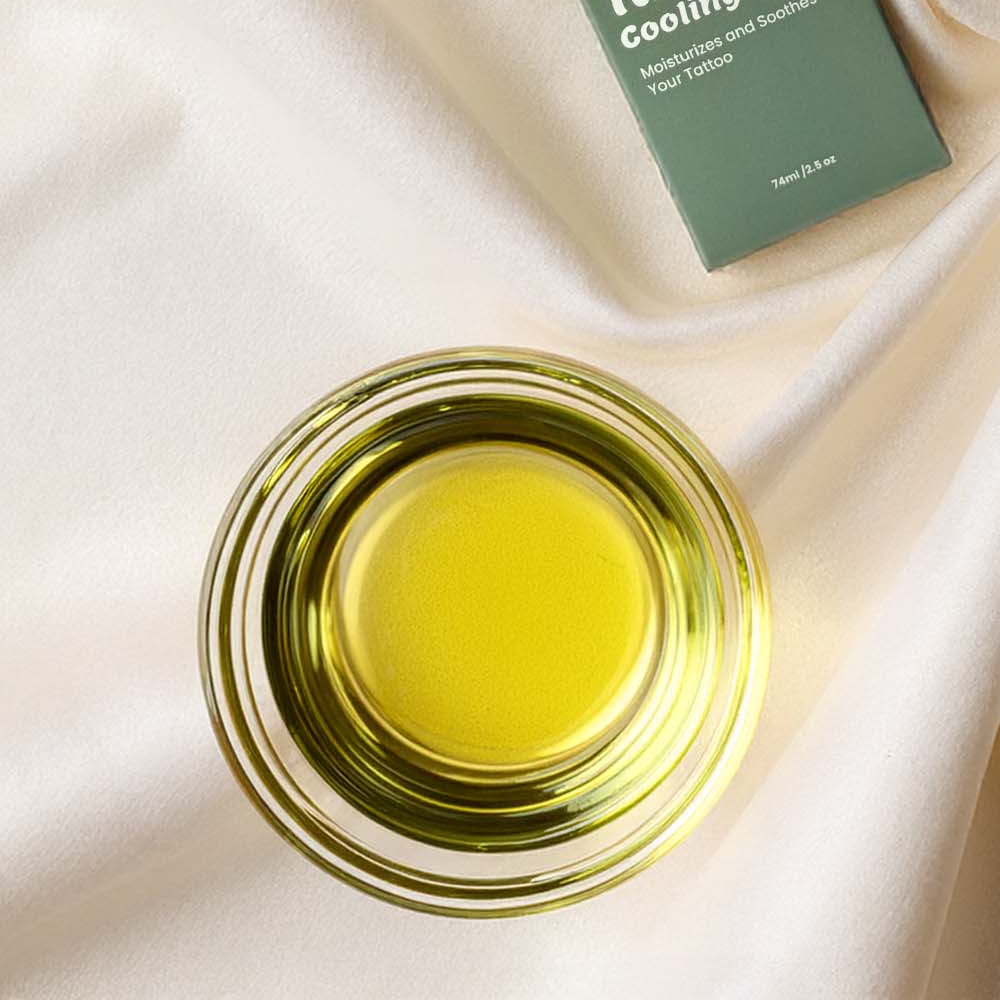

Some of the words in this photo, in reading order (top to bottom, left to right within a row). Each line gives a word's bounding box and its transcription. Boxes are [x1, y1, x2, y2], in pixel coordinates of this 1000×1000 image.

[639, 36, 723, 80] Moisturizes
[725, 20, 756, 43] and
[647, 73, 682, 96] Your
[683, 52, 734, 81] Tattoo
[770, 169, 800, 190] 74ml
[823, 155, 837, 166] oz
